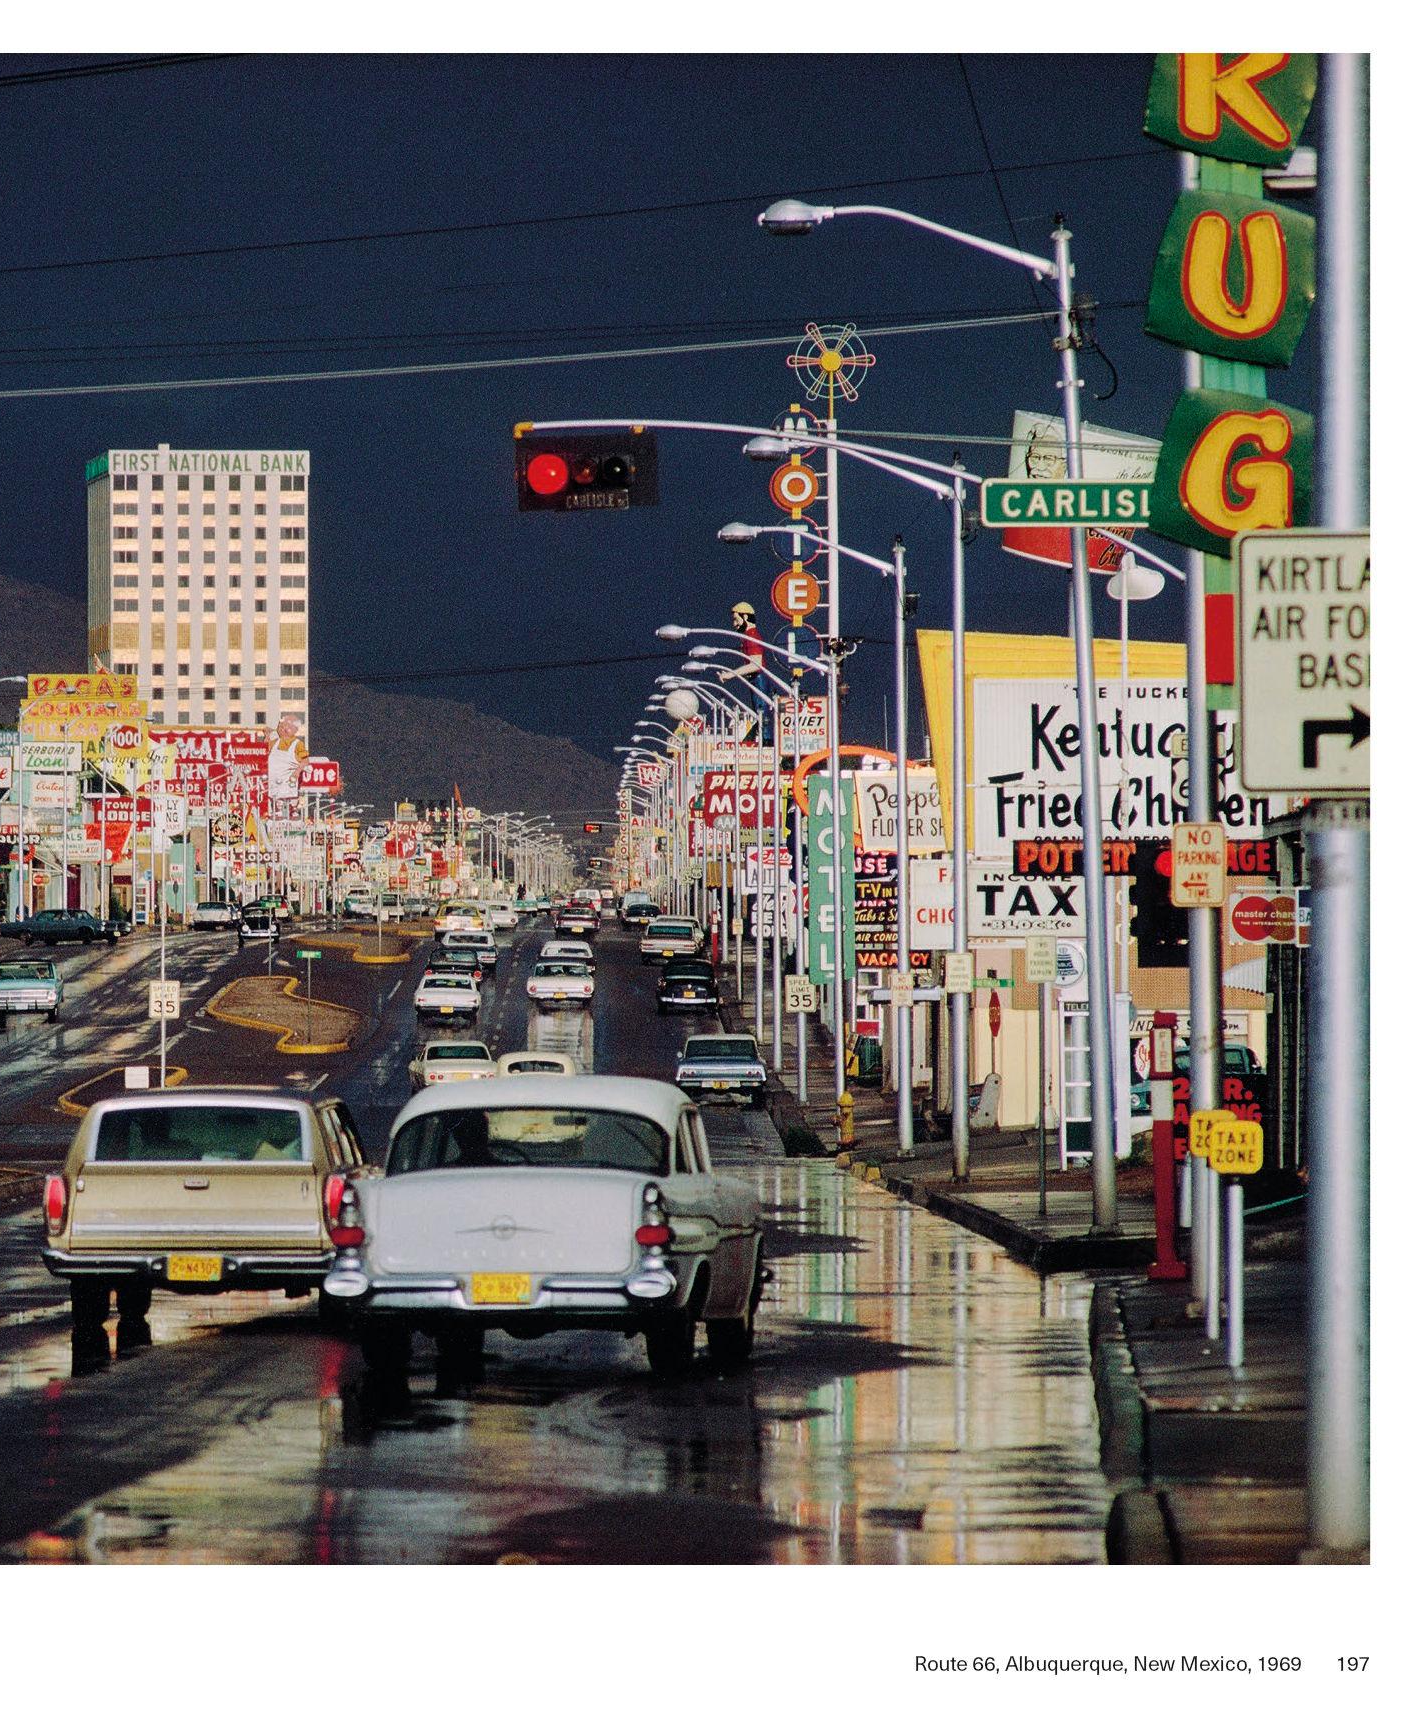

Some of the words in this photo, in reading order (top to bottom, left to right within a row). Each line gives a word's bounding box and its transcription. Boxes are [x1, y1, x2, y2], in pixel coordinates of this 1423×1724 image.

[113, 453, 159, 471] FIRST
[169, 453, 251, 471] NATIONAL
[261, 453, 305, 471] BANK
[1253, 605, 1305, 641] AIR
[1298, 653, 1370, 689] BAS
[33, 678, 135, 697] BACA'S
[1072, 687, 1107, 699] TE
[1031, 702, 1235, 774] Kentuc
[143, 783, 201, 793] RODSIDE
[988, 771, 1084, 838] Frie
[1111, 775, 1270, 831] Chien
[872, 819, 923, 837] FLOER
[1187, 831, 1212, 845] NO
[1018, 841, 1137, 873] POTER
[1177, 851, 1221, 866] PARKING
[815, 789, 848, 972] MOTEL
[1188, 872, 1209, 881] ANY
[976, 885, 1078, 917] TAX
[1188, 889, 1212, 899] TIME
[1234, 910, 1268, 919] master
[857, 952, 930, 966] VACACY
[153, 1000, 175, 1013] 35
[789, 994, 813, 1008] 35
[1223, 1077, 1254, 1100] R.
[1216, 1131, 1256, 1144] TAXI
[1216, 1150, 1255, 1163] ZONE
